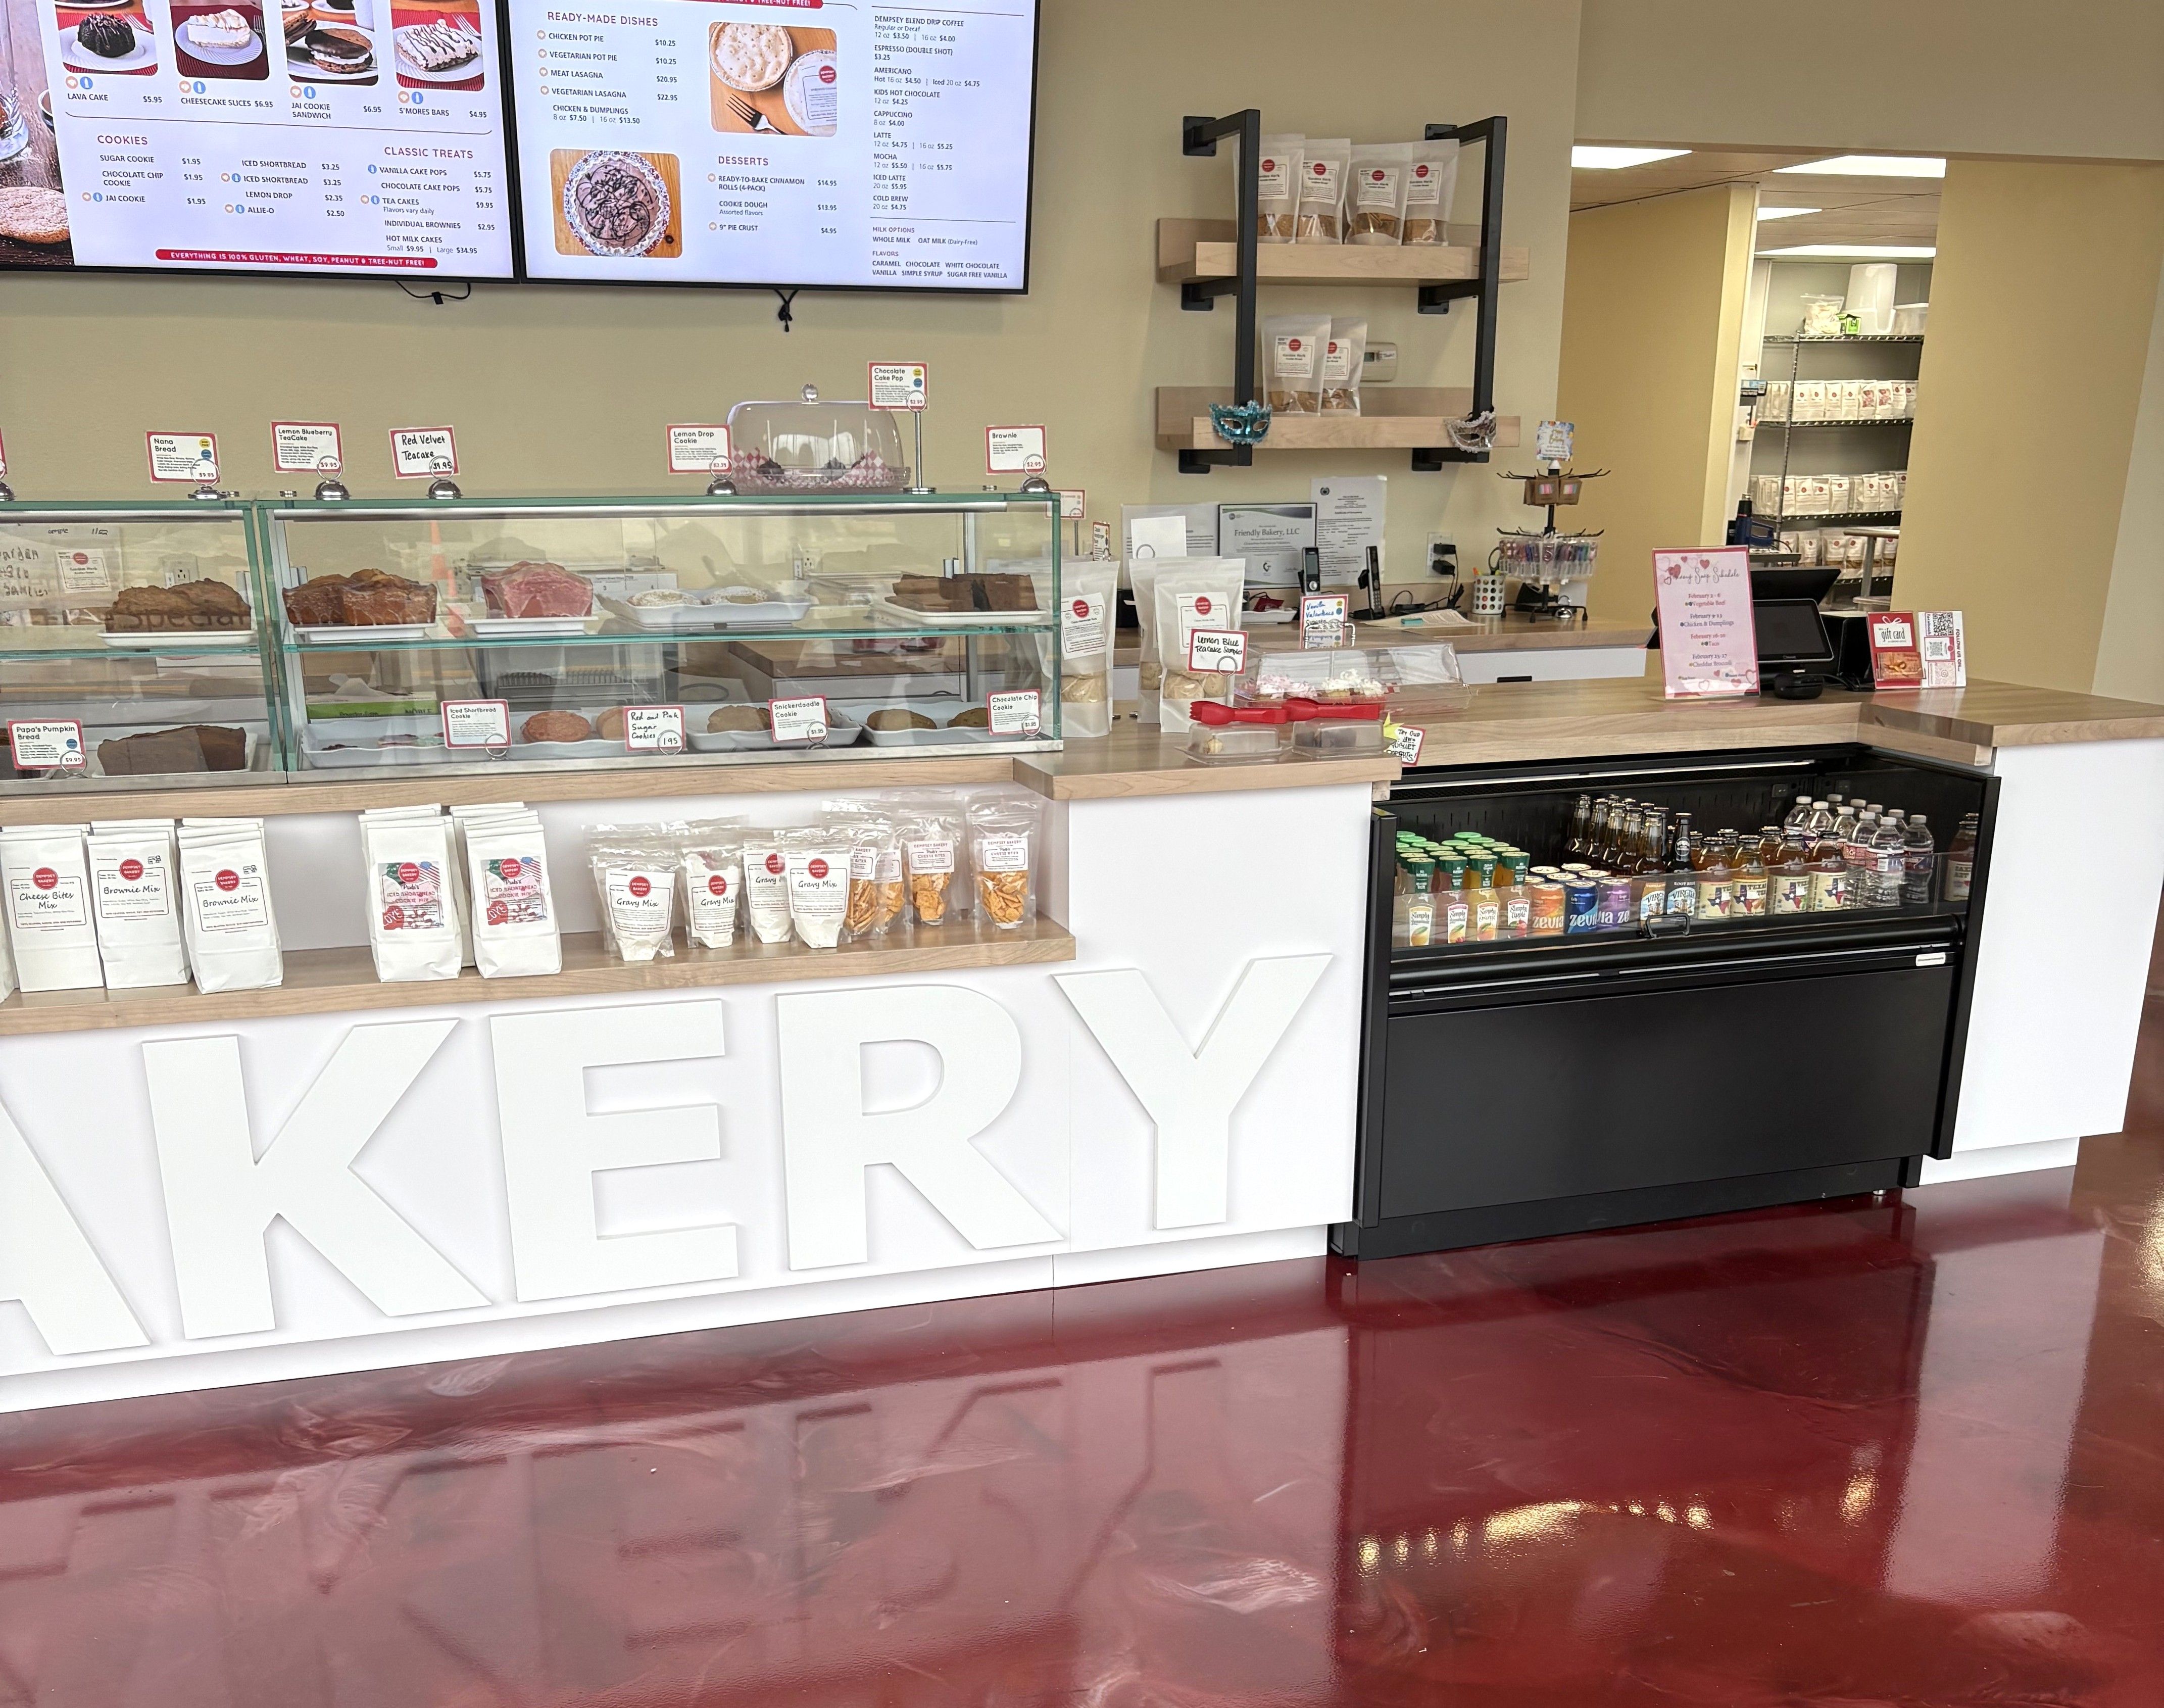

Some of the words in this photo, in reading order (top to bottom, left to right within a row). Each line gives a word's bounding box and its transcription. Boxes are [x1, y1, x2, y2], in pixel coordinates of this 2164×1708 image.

[548, 12, 616, 24] READY-MADE
[621, 16, 658, 26] DISHES
[552, 88, 593, 96] VEGETARIAN
[97, 135, 147, 144] COOKIES
[384, 147, 428, 157] CLASSIC
[432, 149, 473, 159] TREATS
[719, 156, 768, 166] DESSERTS
[401, 434, 418, 446] Red
[419, 434, 446, 444] Velvet
[1235, 529, 1260, 538] Friendly
[1881, 627, 1892, 642] gift
[1893, 627, 1905, 639] card
[1198, 636, 1219, 645] Lemon
[1222, 638, 1239, 646] Blue
[774, 701, 820, 710] Snickerdoodle
[631, 711, 644, 721] Red
[632, 723, 657, 733] Sugar
[756, 876, 777, 885] Gravy
[798, 880, 819, 889] Gravy
[822, 880, 838, 888] Mix
[104, 886, 141, 894] Brownie
[142, 885, 161, 893] Mix
[20, 893, 50, 901] Cheese
[53, 891, 74, 899] Bites
[203, 897, 239, 907] Brownie
[241, 895, 259, 903] Mix
[38, 901, 58, 909] Mix
[617, 898, 640, 908] Gravy
[642, 899, 659, 907] Mix
[1411, 912, 1430, 920] Simply
